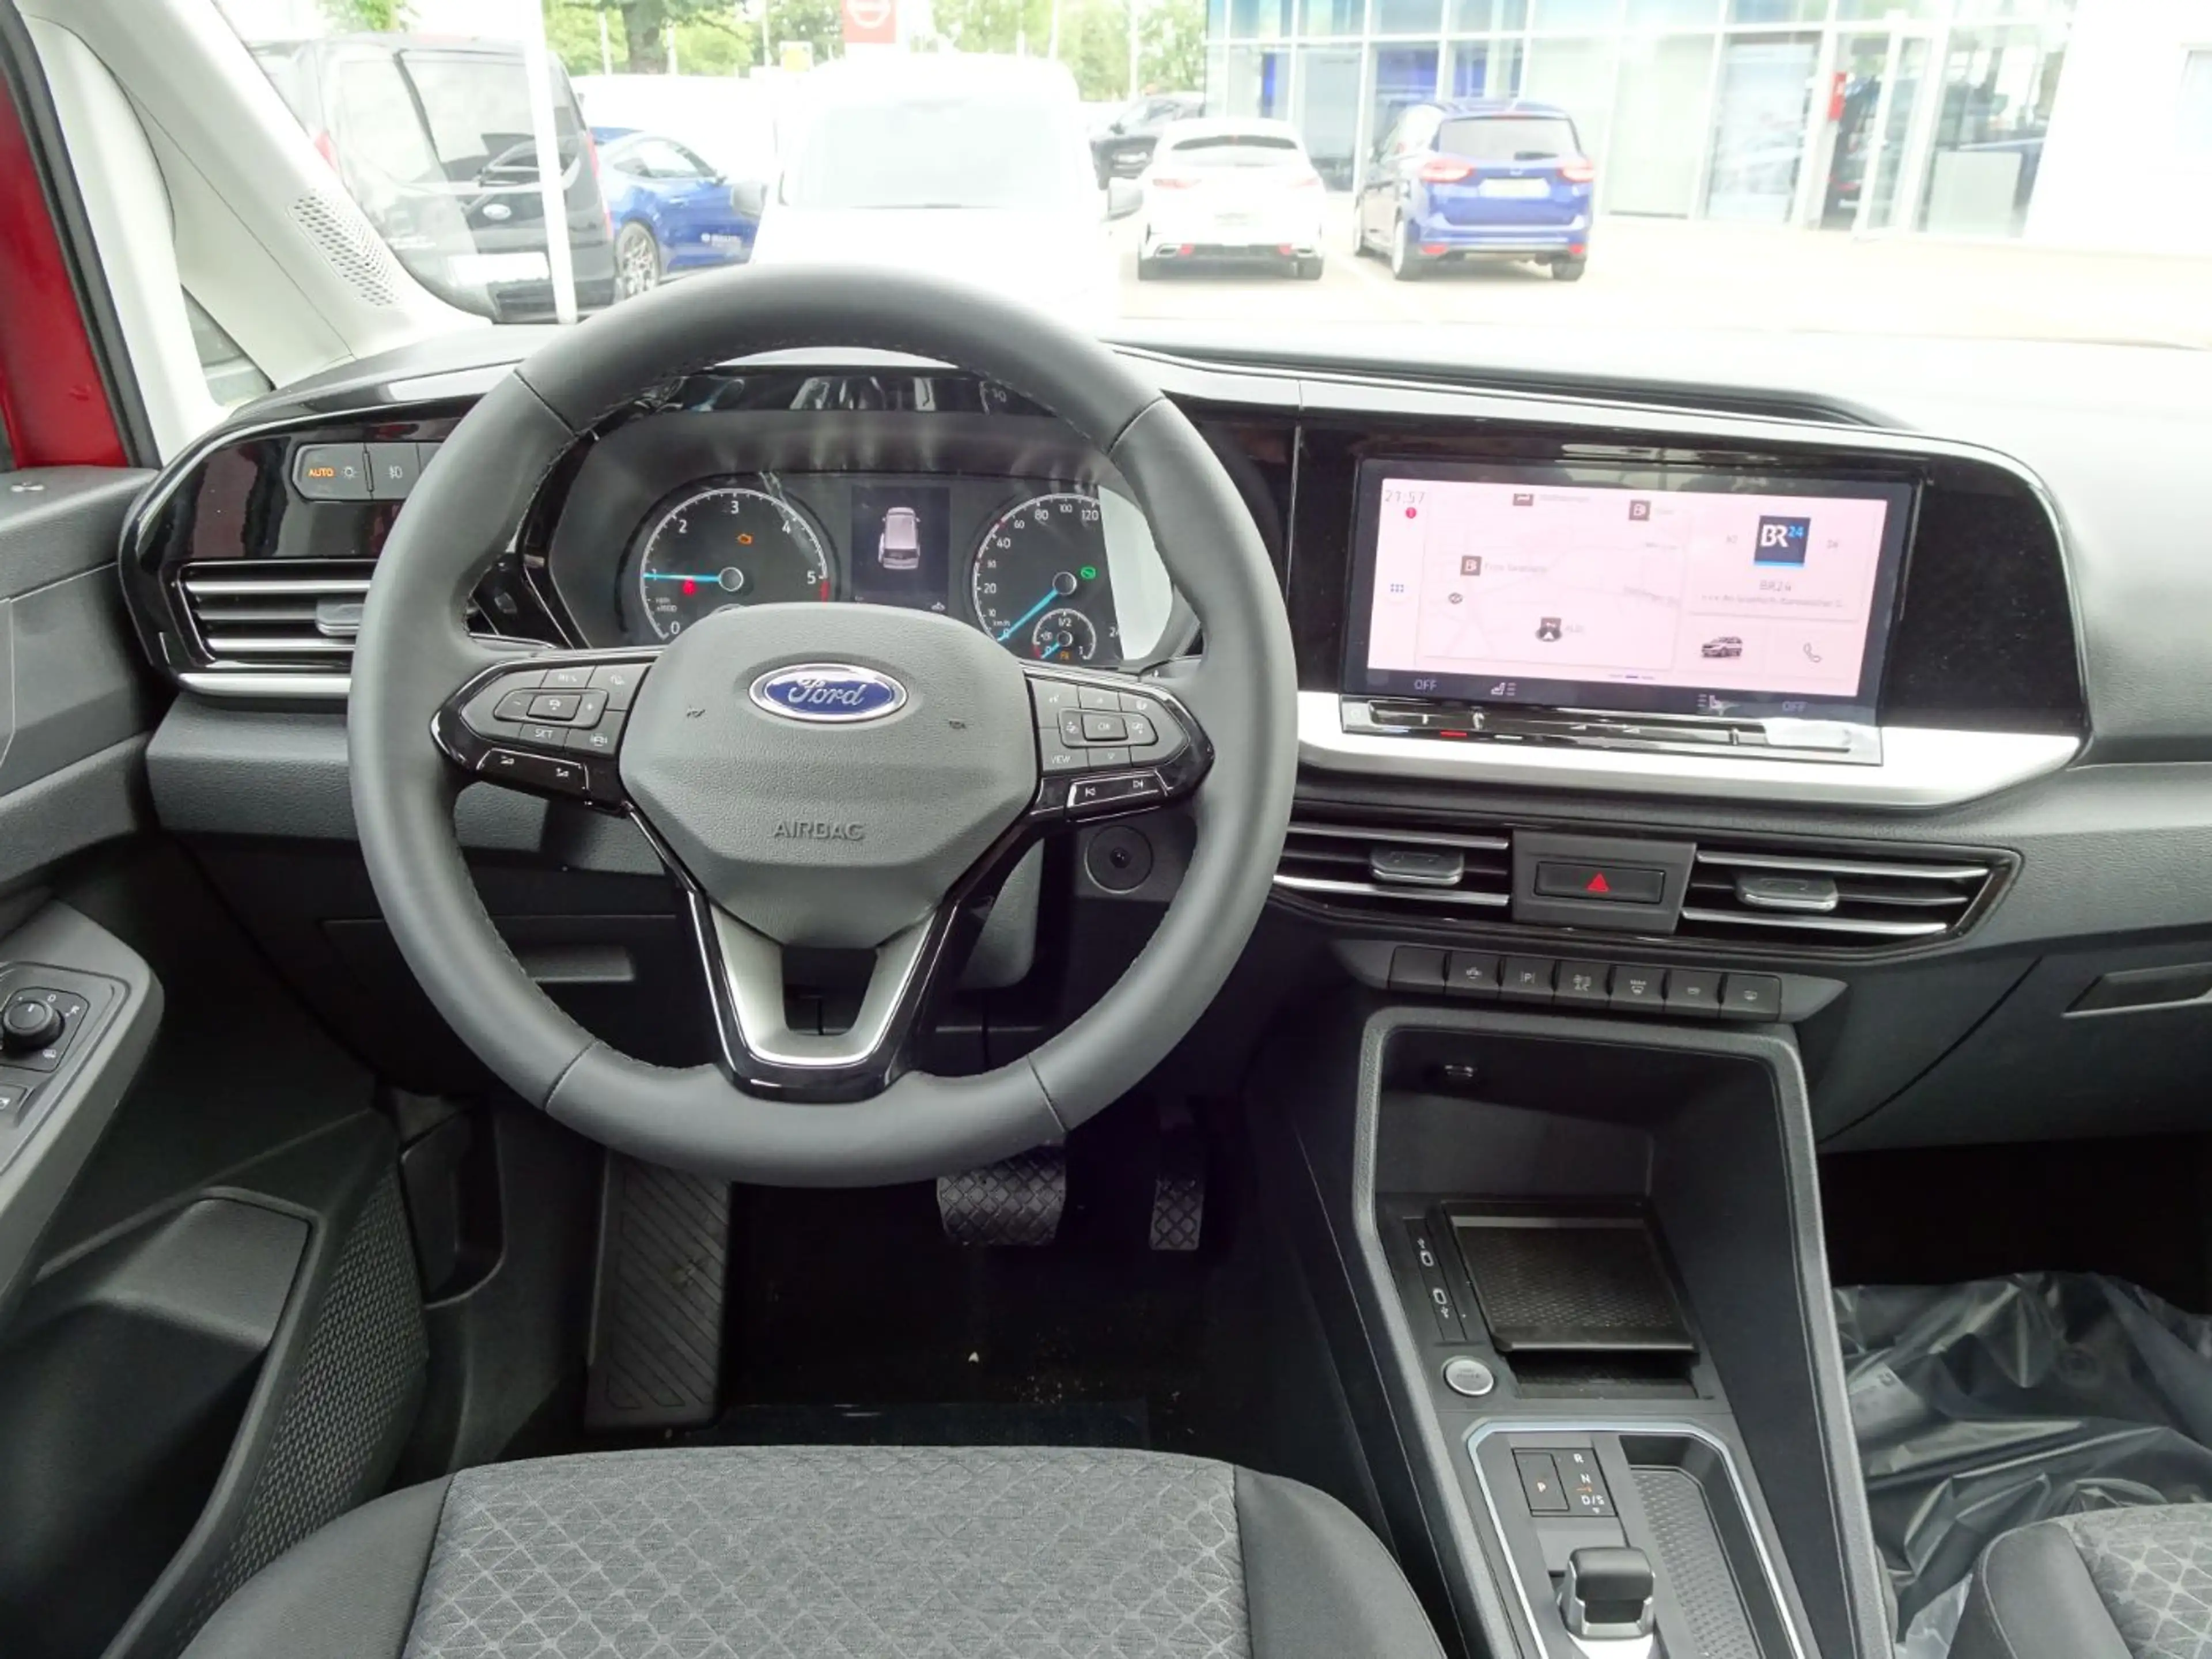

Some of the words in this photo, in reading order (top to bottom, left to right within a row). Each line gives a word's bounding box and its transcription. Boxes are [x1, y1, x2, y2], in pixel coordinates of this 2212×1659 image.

[309, 468, 335, 478] AUTO
[1384, 490, 1425, 505] 21:57
[730, 501, 740, 514] 3
[1059, 503, 1073, 513] 100
[1035, 509, 1049, 521] 80
[1081, 509, 1099, 521] 120
[679, 520, 687, 533] 2
[781, 520, 791, 535] 4
[1014, 520, 1025, 529] 60
[996, 537, 1011, 549] 40
[807, 570, 817, 585] 5
[984, 583, 997, 594] 20
[671, 621, 680, 635] 0
[1414, 679, 1438, 692] OFF
[787, 678, 867, 706] Ford
[1782, 701, 1808, 711] OFF
[1098, 722, 1111, 730] OK
[535, 728, 553, 740] SET
[1051, 755, 1071, 764] VIEW
[774, 821, 865, 842] AIRBAG
[1573, 1453, 1584, 1464] R
